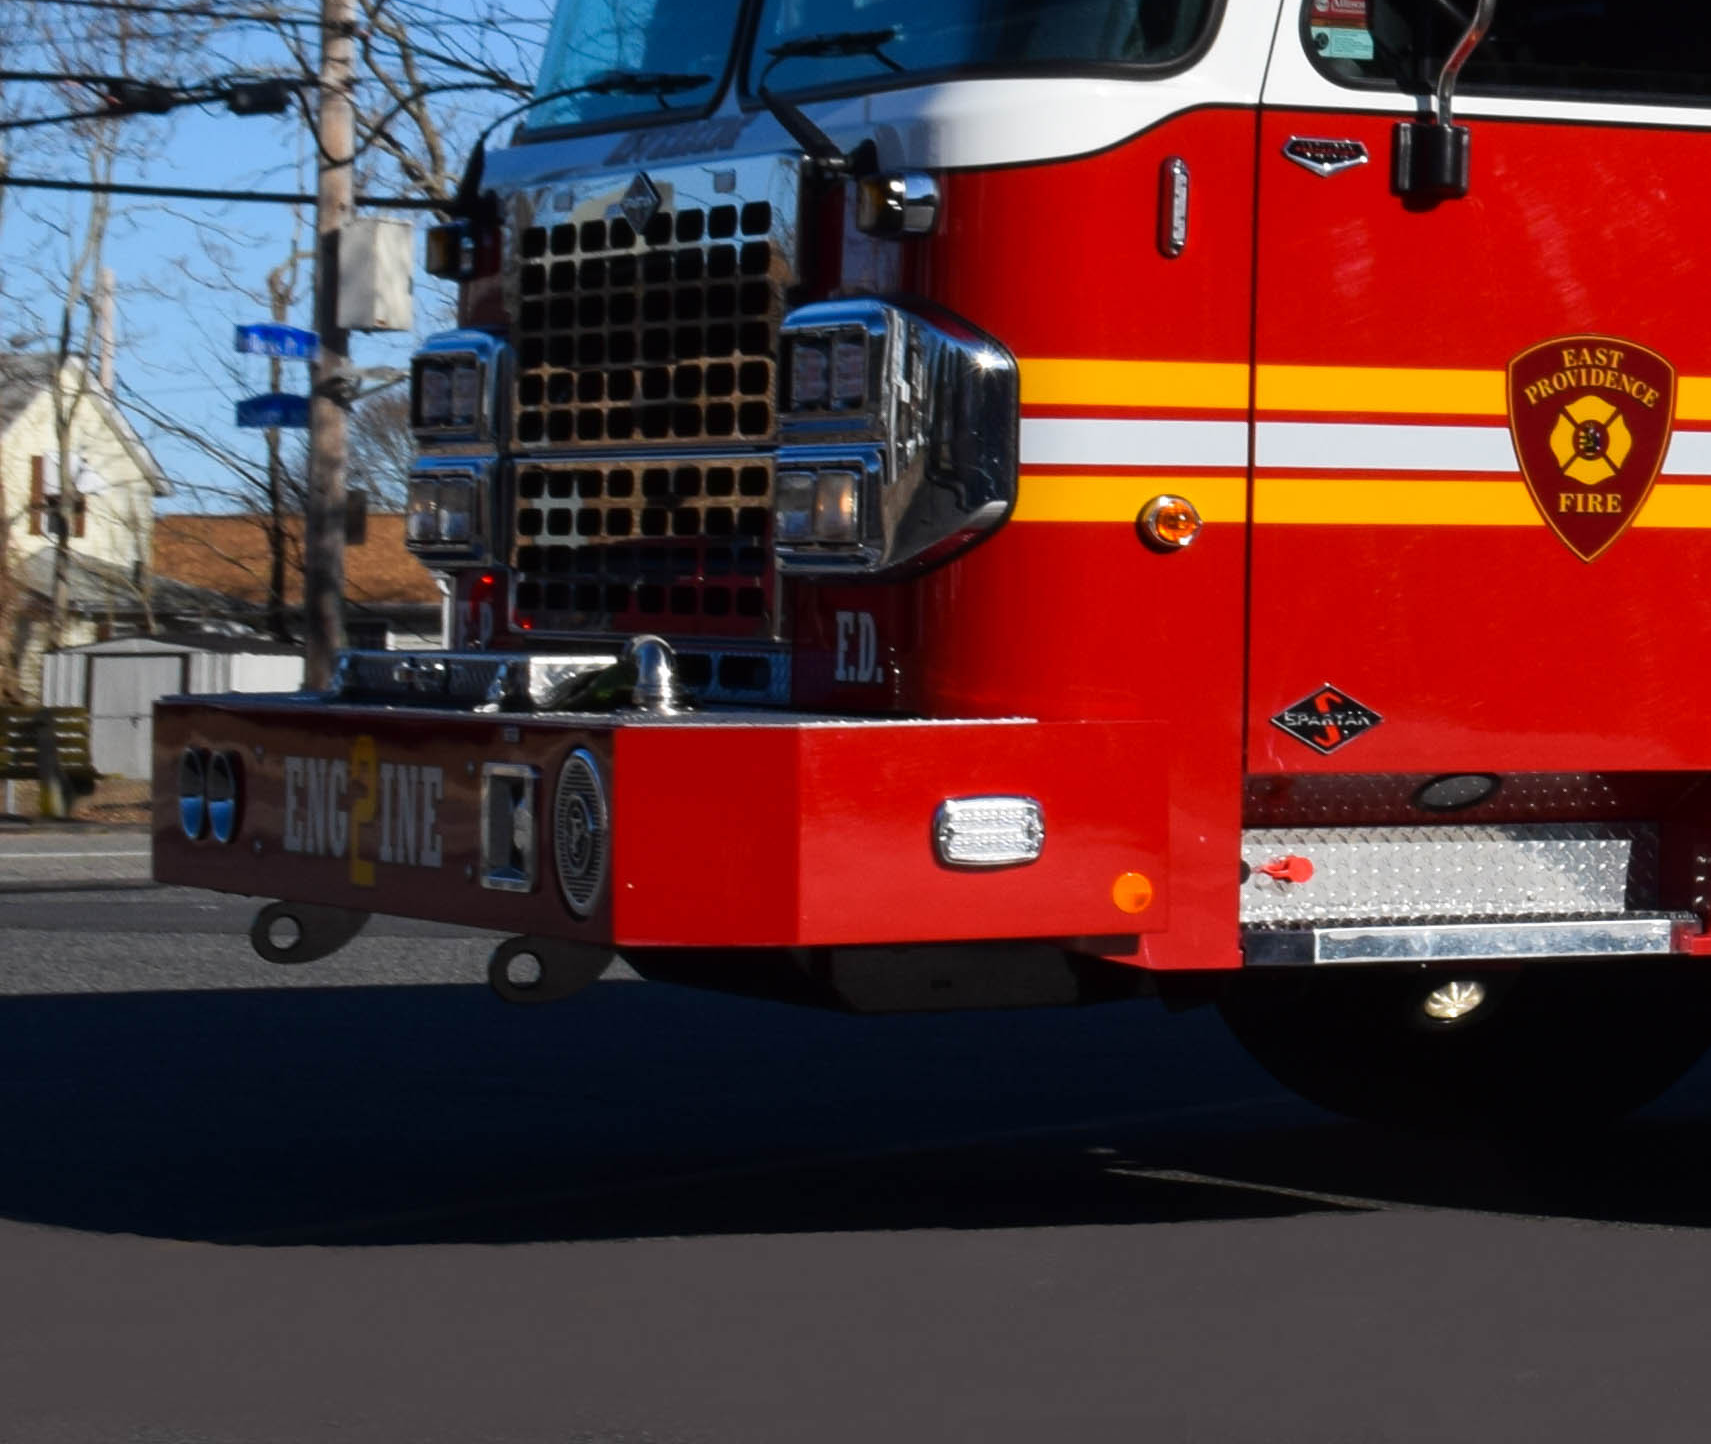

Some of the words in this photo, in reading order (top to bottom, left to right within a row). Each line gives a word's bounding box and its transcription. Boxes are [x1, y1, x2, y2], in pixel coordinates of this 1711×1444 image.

[1562, 348, 1624, 368] EAST
[1524, 368, 1659, 407] PROVIDENCE
[1559, 493, 1622, 513] FIRE
[835, 611, 884, 683] F.D.
[1284, 711, 1372, 726] SPARTAN
